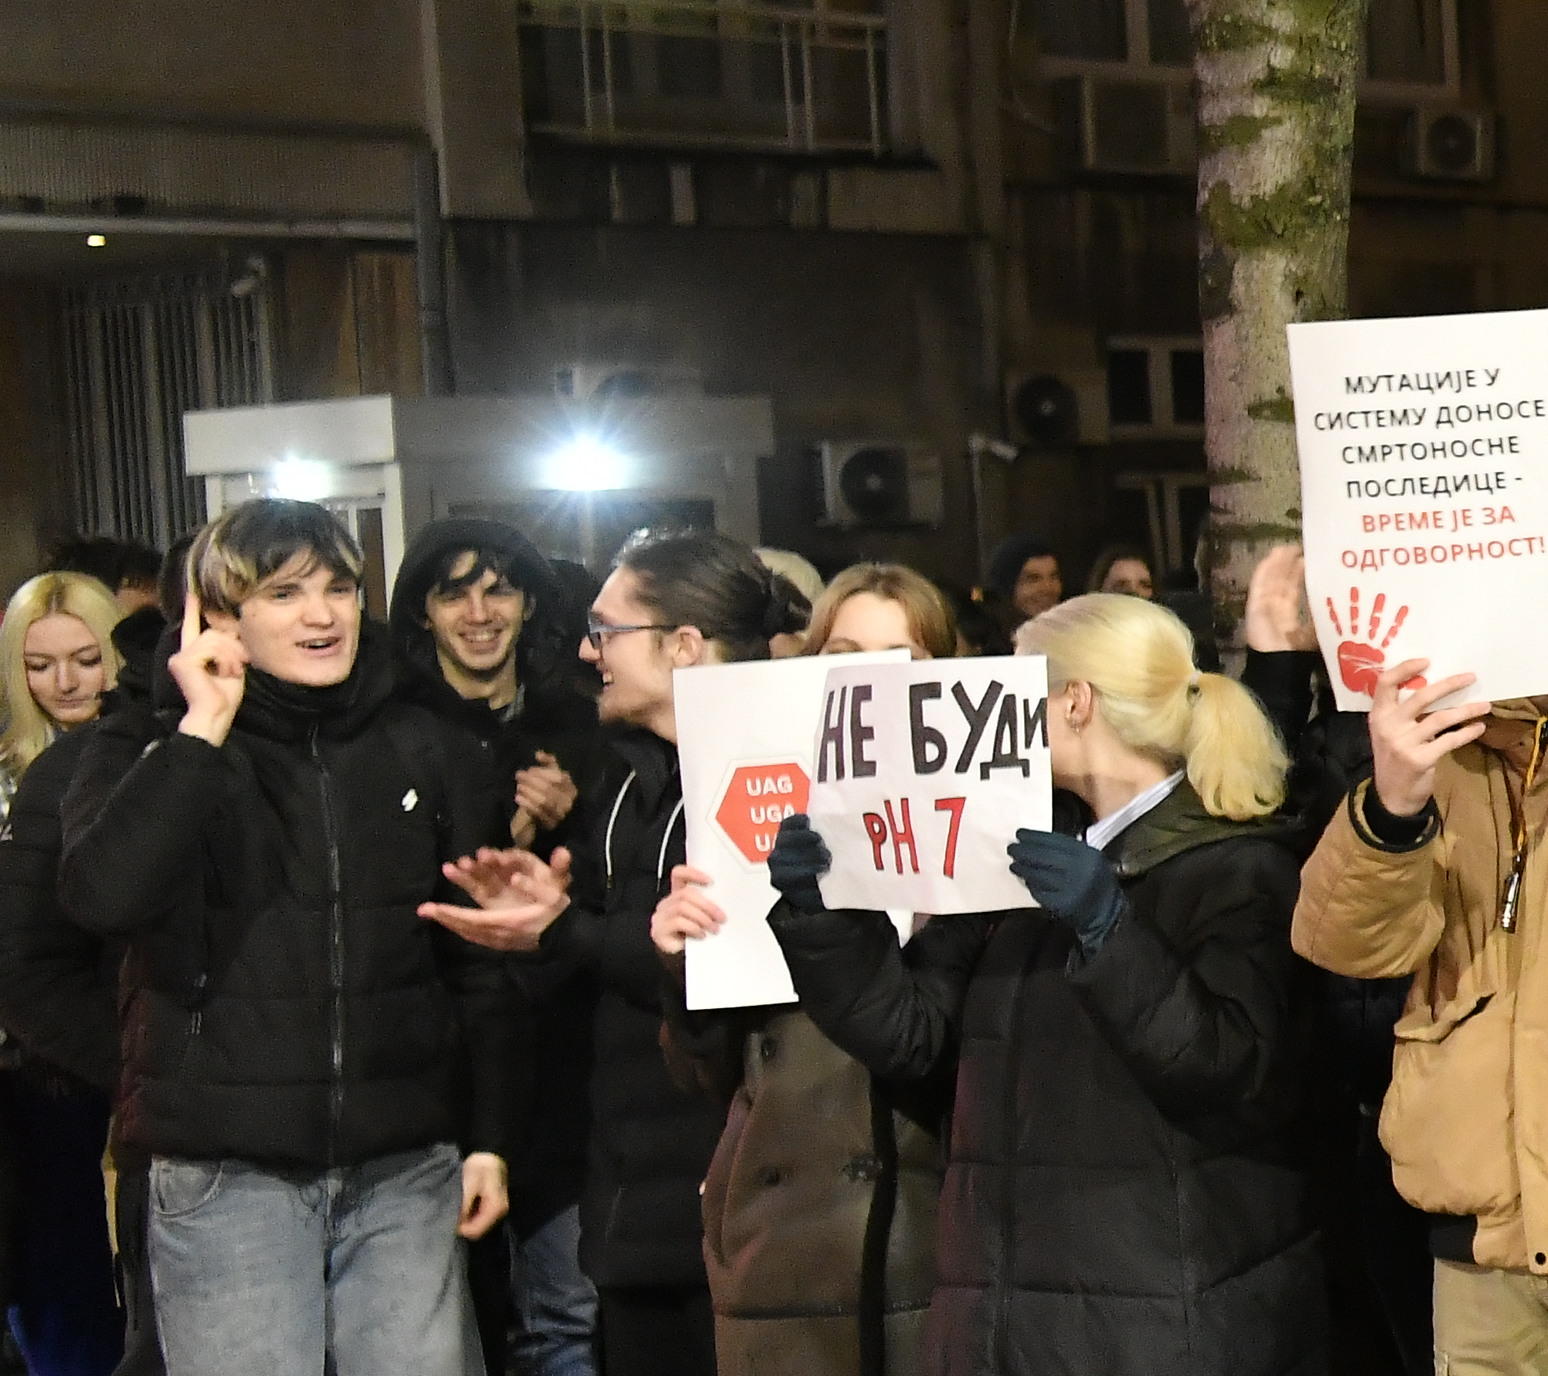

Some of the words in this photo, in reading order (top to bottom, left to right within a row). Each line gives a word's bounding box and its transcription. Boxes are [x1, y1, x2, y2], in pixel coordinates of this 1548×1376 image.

[1344, 369, 1477, 395] МУТАЦИЈЕ
[1484, 367, 1500, 387] У
[1314, 407, 1427, 431] СИСТЕМУ
[1435, 399, 1546, 430] ДОНОСЕ
[1341, 435, 1520, 465] СМРТОНОСНЕ
[1346, 471, 1507, 499] ПОСЛЕДИЦЕ
[1361, 510, 1444, 534] ВРЕМЕ
[1451, 508, 1474, 533] ЈЕ
[1481, 505, 1516, 526] ЗА
[1341, 536, 1545, 573] ОДГОВОРНОСТ!
[817, 684, 877, 784] НЕ
[908, 679, 1050, 781] БУДИ
[746, 774, 793, 796] UAG
[750, 803, 795, 824] UGA
[934, 796, 967, 880] 7
